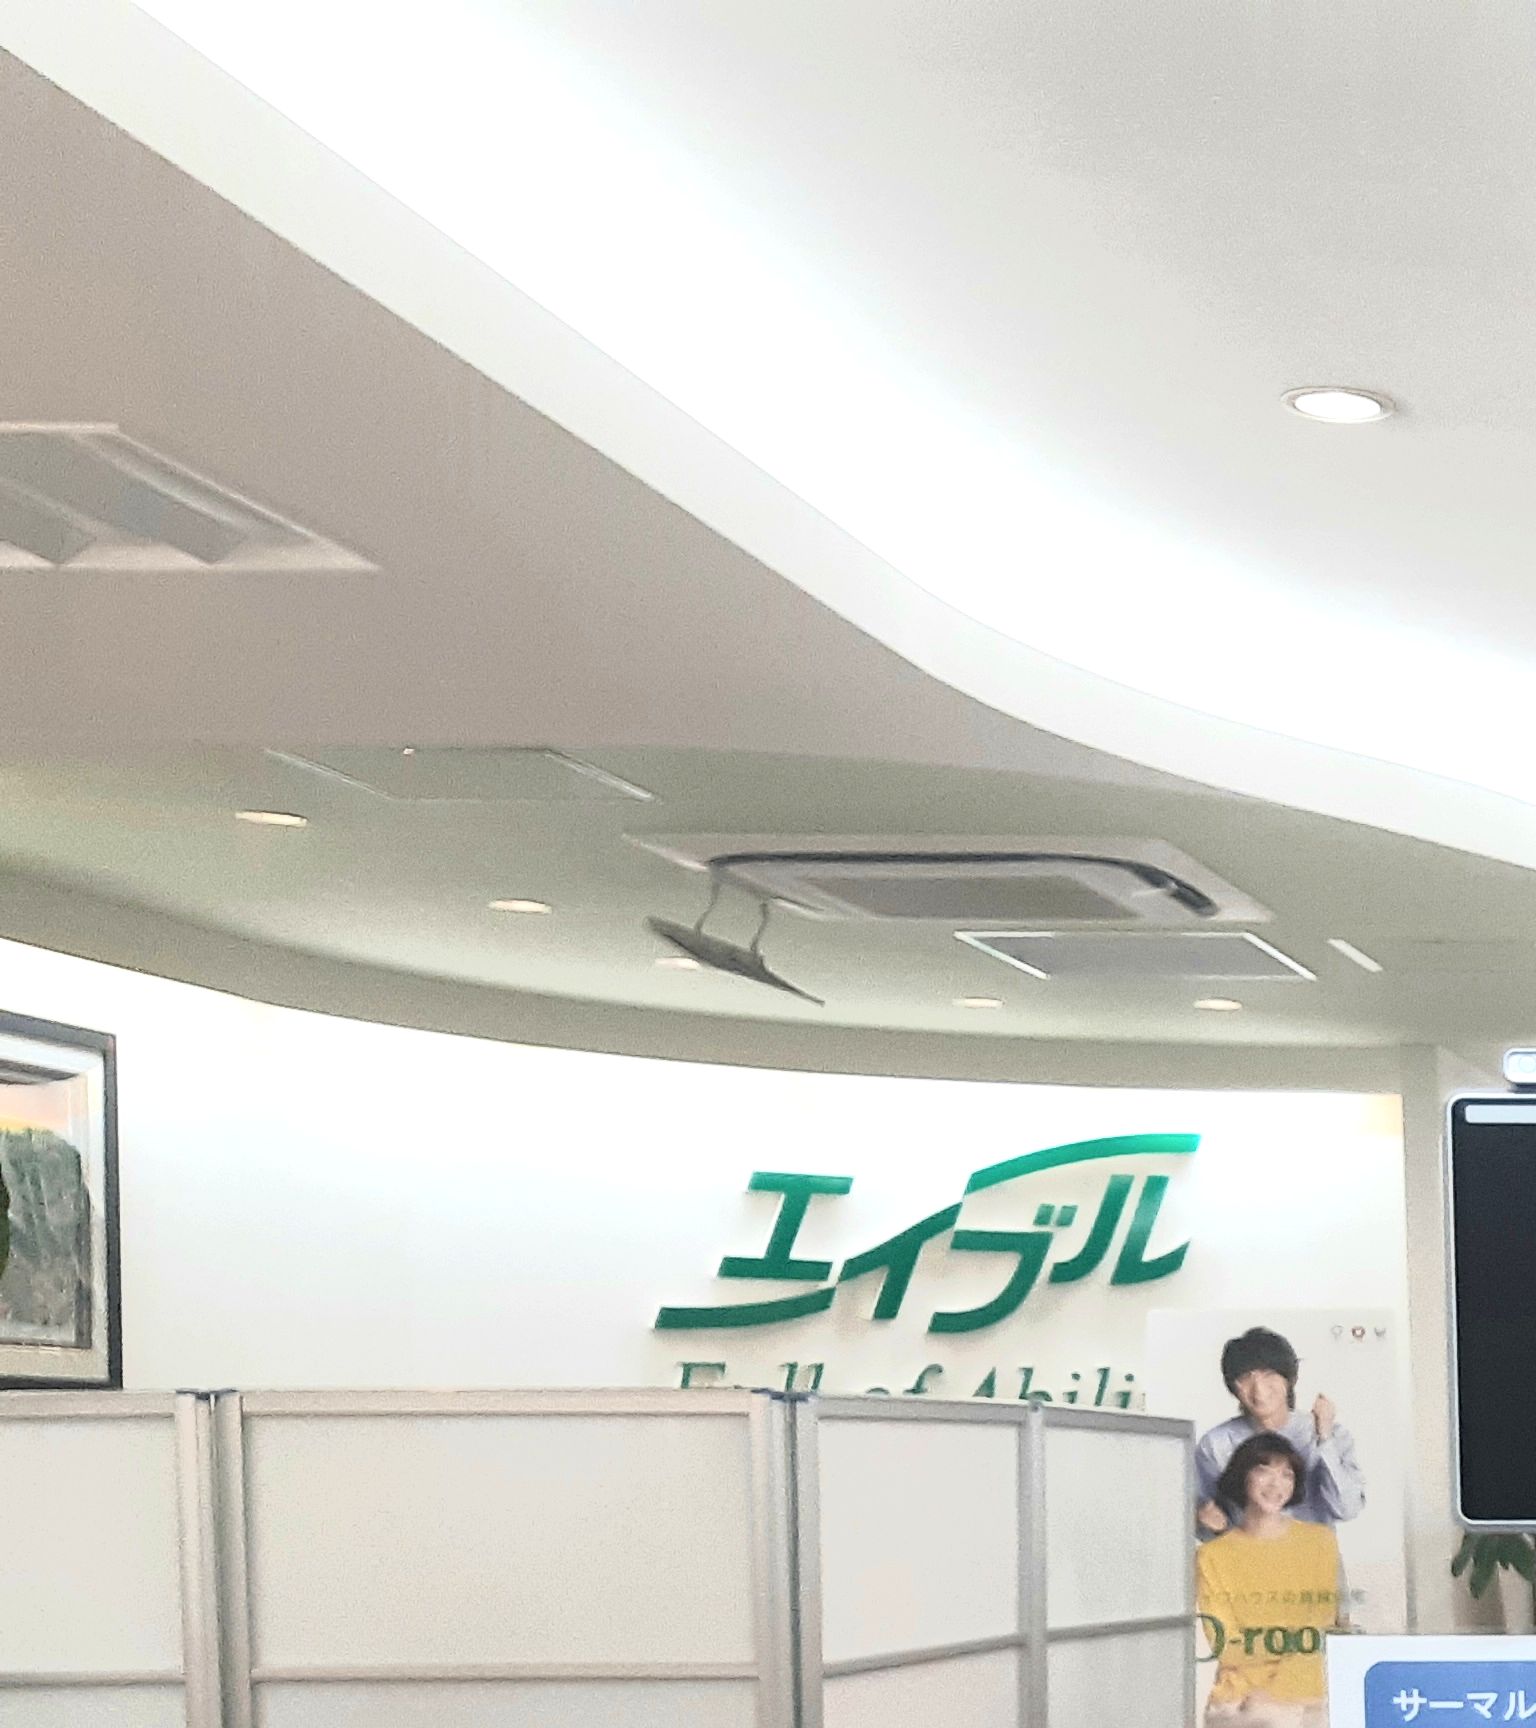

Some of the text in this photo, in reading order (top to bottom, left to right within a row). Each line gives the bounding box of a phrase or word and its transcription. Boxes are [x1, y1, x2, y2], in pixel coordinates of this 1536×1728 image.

[655, 1133, 1200, 1335] エイブル
[677, 1361, 1146, 1411] Fll f Abili
[1196, 1613, 1328, 1662] D-roo
